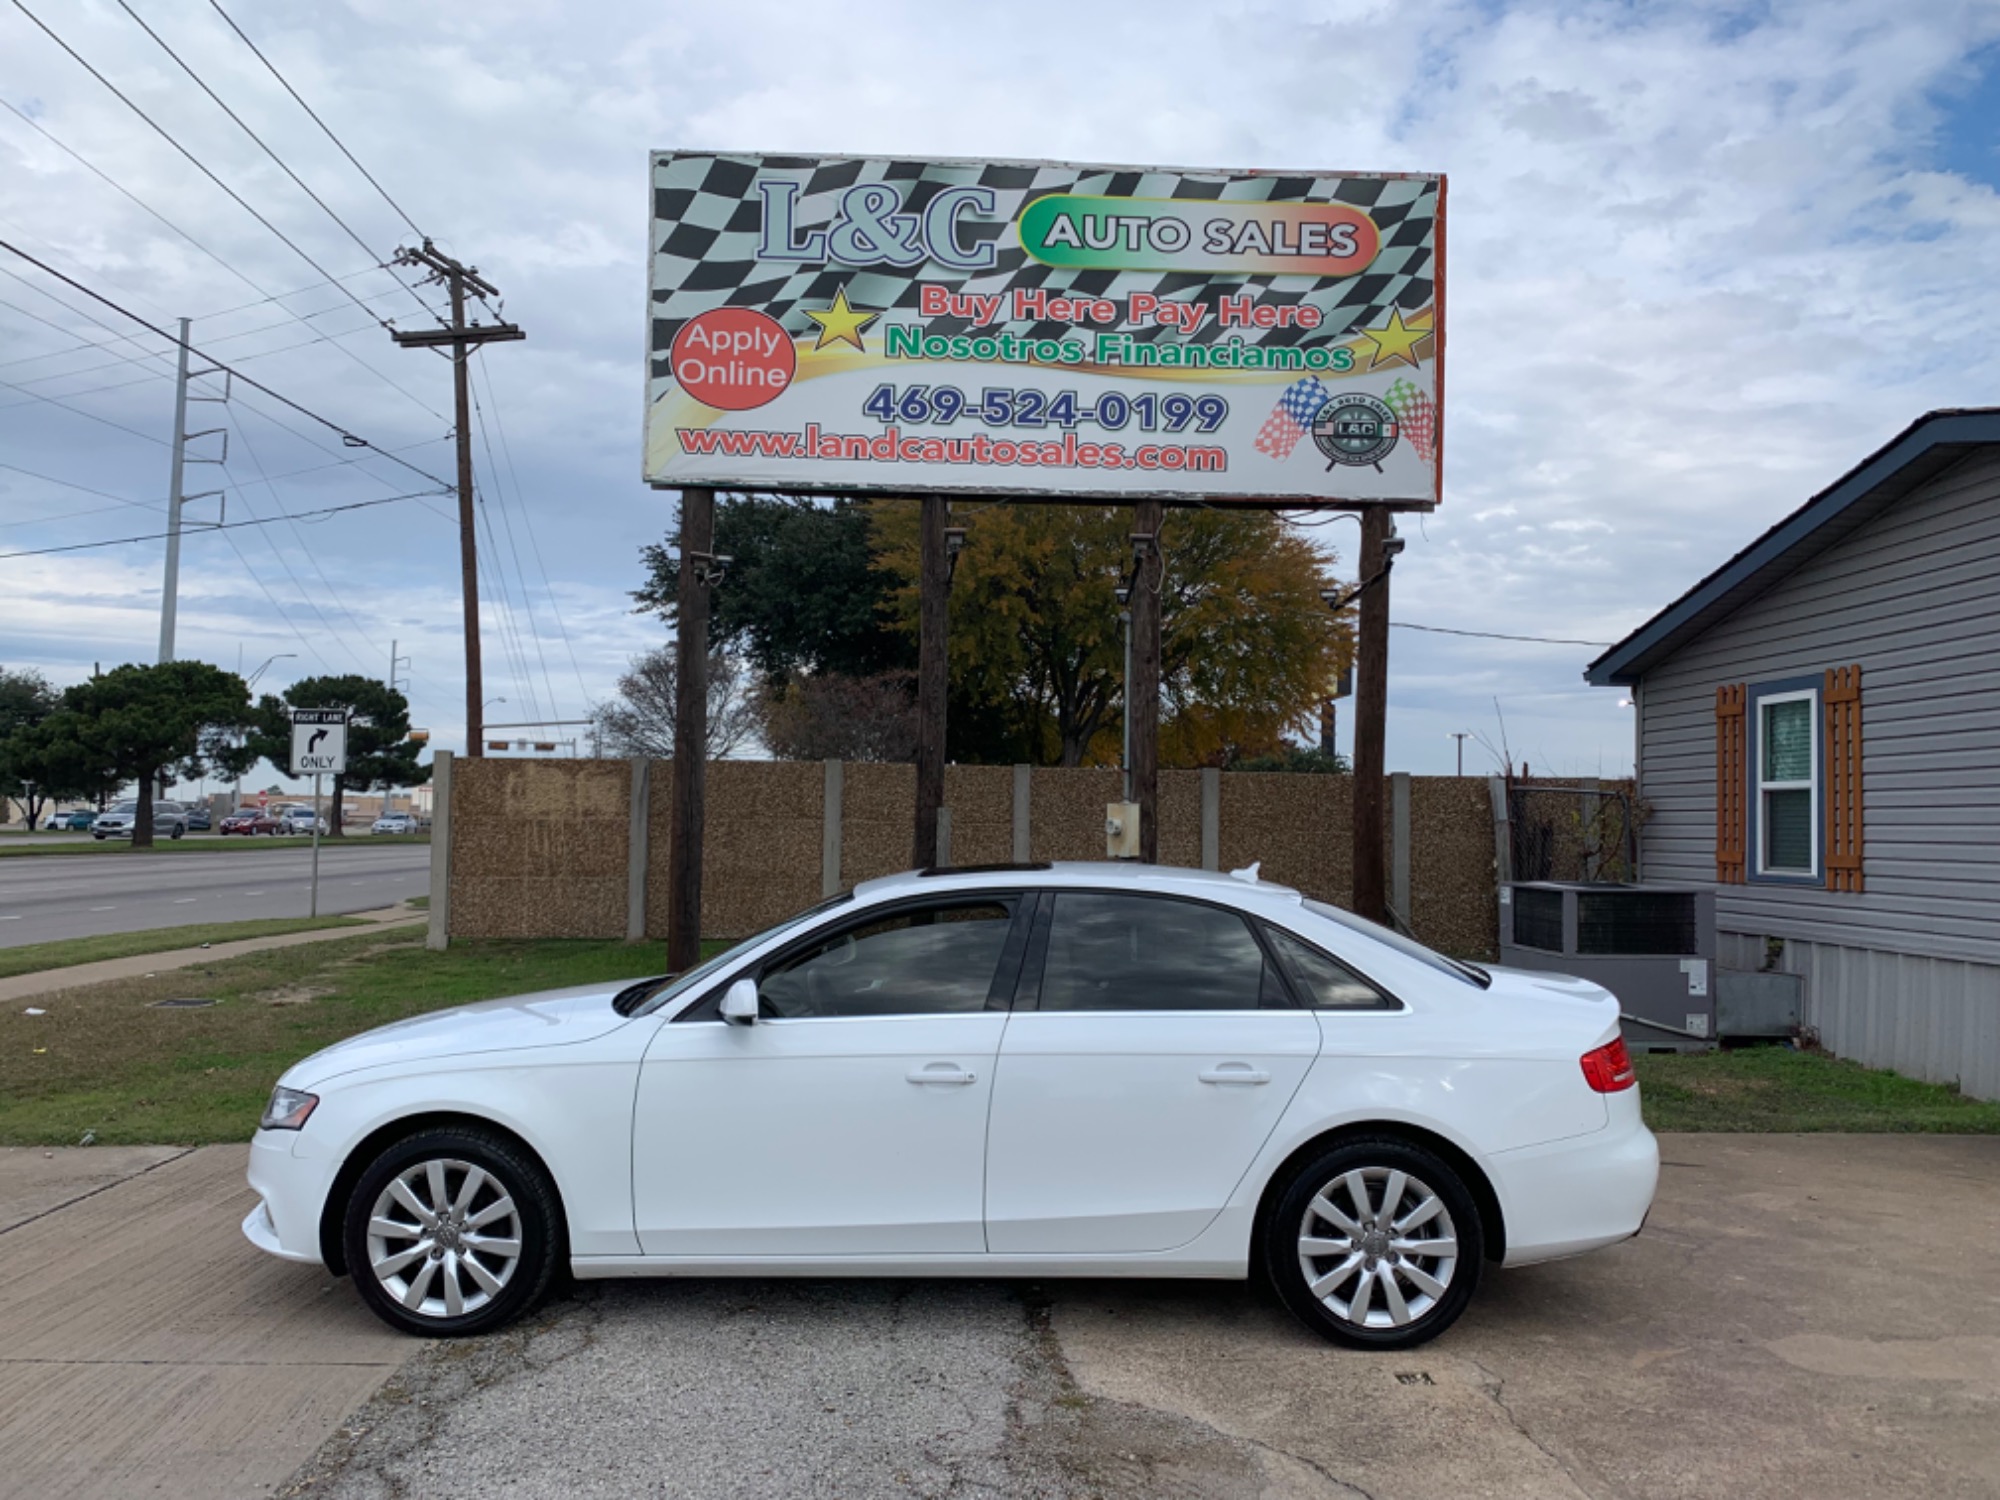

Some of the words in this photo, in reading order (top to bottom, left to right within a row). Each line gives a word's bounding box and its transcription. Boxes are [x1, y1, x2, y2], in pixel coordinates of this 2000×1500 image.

[757, 181, 996, 267] L&C
[1043, 213, 1191, 252] AUTO
[1202, 218, 1359, 258] SALES
[919, 284, 1003, 325] Buy
[1013, 289, 1116, 322] Here
[1128, 293, 1208, 333] Pay
[1218, 295, 1323, 328] Here
[683, 322, 781, 355] Apply
[885, 324, 1085, 364] Nosotros
[1095, 334, 1355, 371] Financiamos
[676, 358, 787, 388] Online
[863, 384, 1228, 433] 469-524-0199
[1338, 422, 1375, 436] L&C
[675, 423, 1228, 472] www.landcautosales.com
[322, 714, 343, 722] LANE
[301, 756, 336, 768] ONLY
